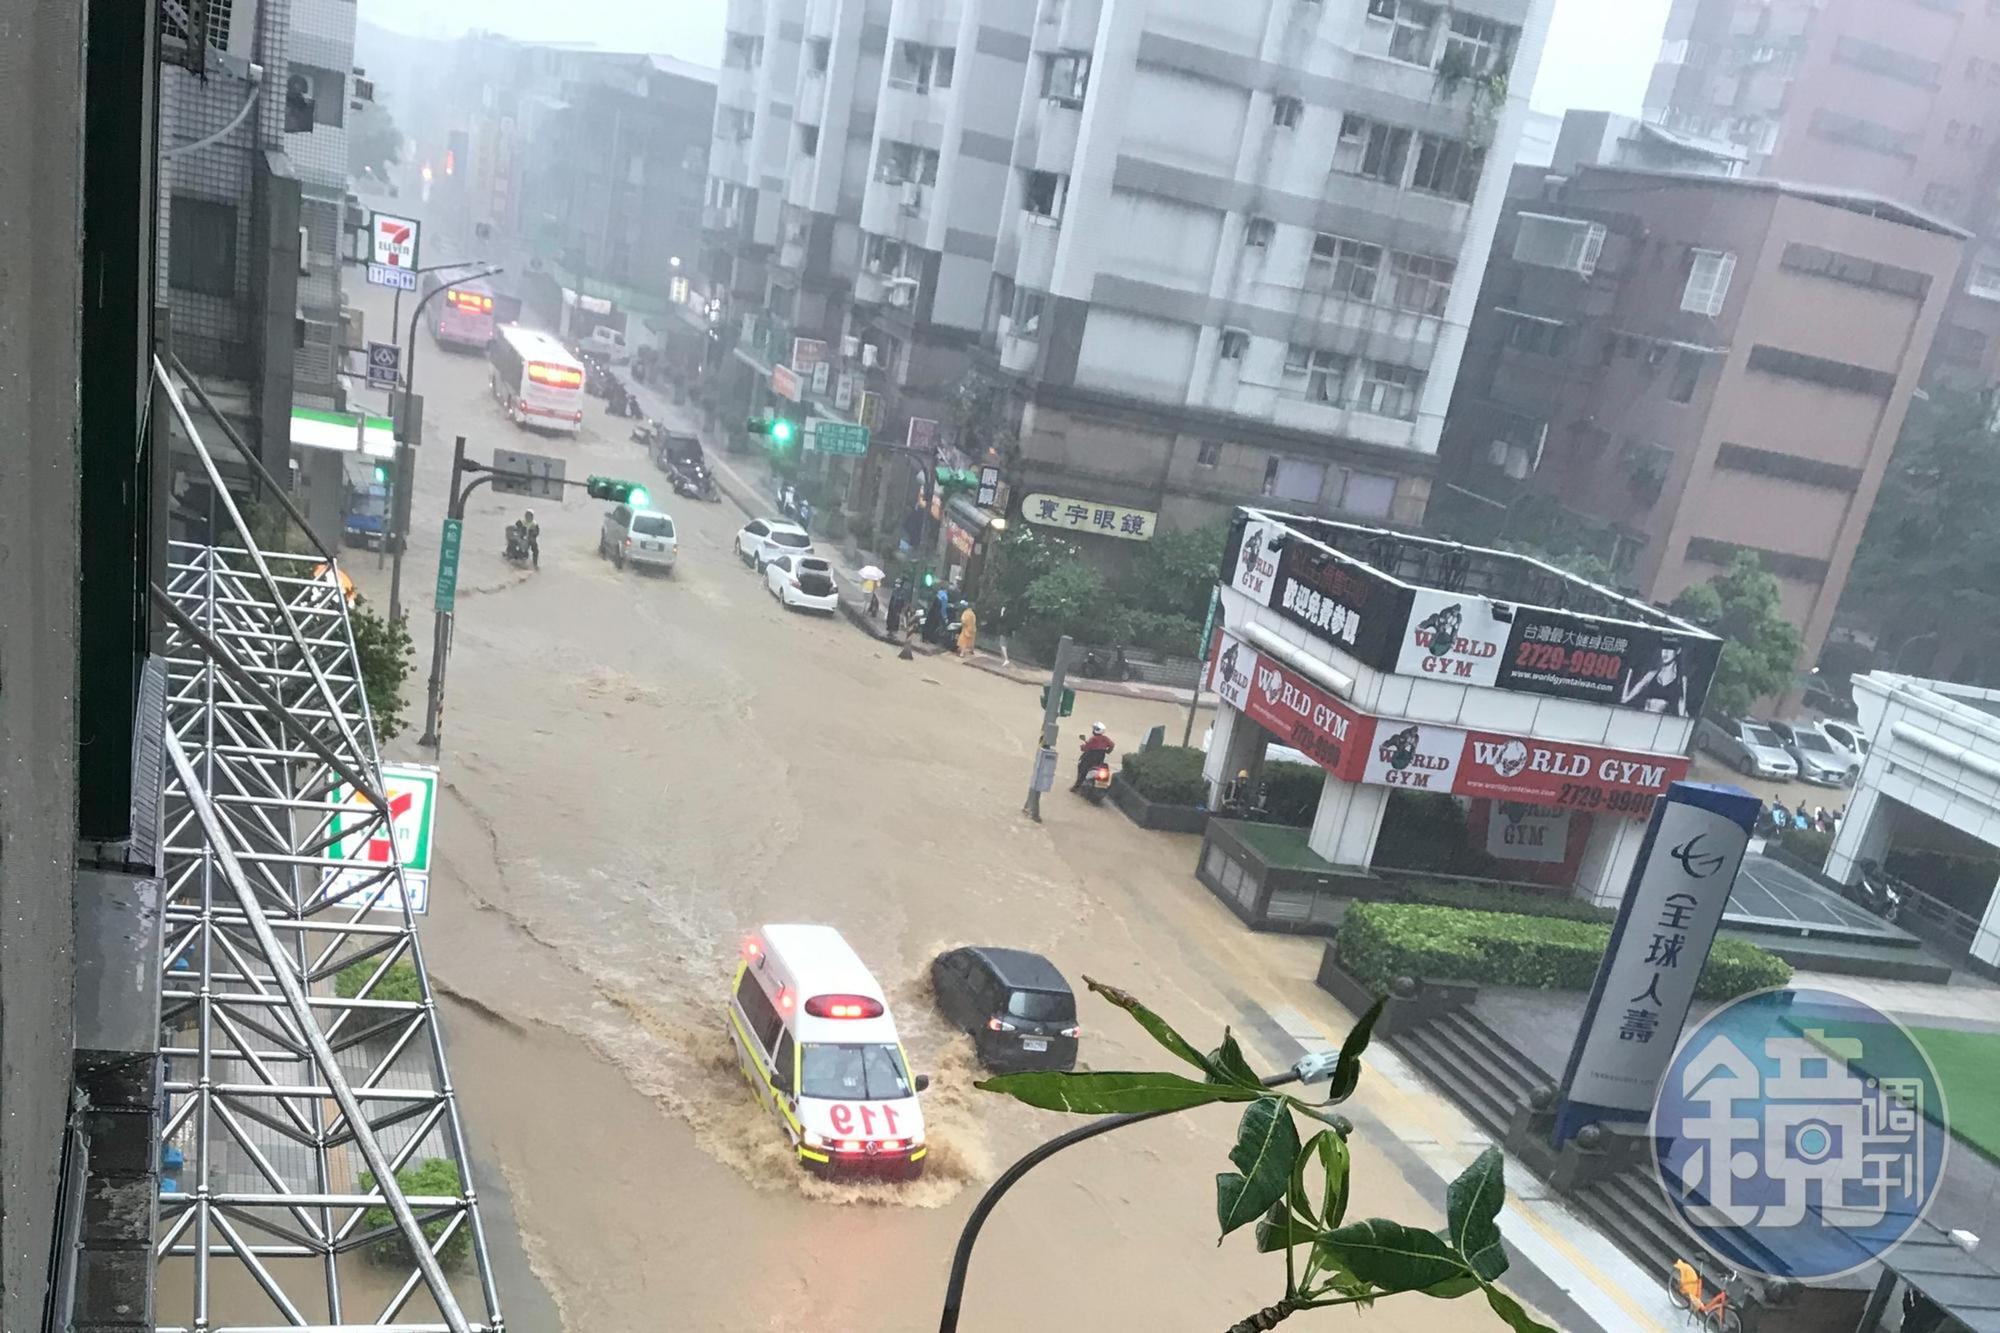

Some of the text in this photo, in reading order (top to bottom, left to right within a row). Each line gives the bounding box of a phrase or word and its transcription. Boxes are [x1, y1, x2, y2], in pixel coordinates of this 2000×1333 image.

[381, 221, 410, 266] 7
[1242, 571, 1264, 593] GYM
[1523, 624, 1629, 653] 台灣最大健身品牌
[1421, 656, 1474, 678] GYM
[1515, 641, 1621, 679] 2729-9990
[1220, 680, 1239, 703] GYM
[1511, 670, 1614, 692] www.worldgymtaiwan.com
[1258, 666, 1311, 717] WORLD
[1313, 703, 1349, 742] GYM
[1473, 738, 1668, 788] WORLD GYM
[1385, 769, 1431, 788] GYM
[1503, 823, 1545, 846] GYM
[1619, 892, 1698, 1044] 全球人壽
